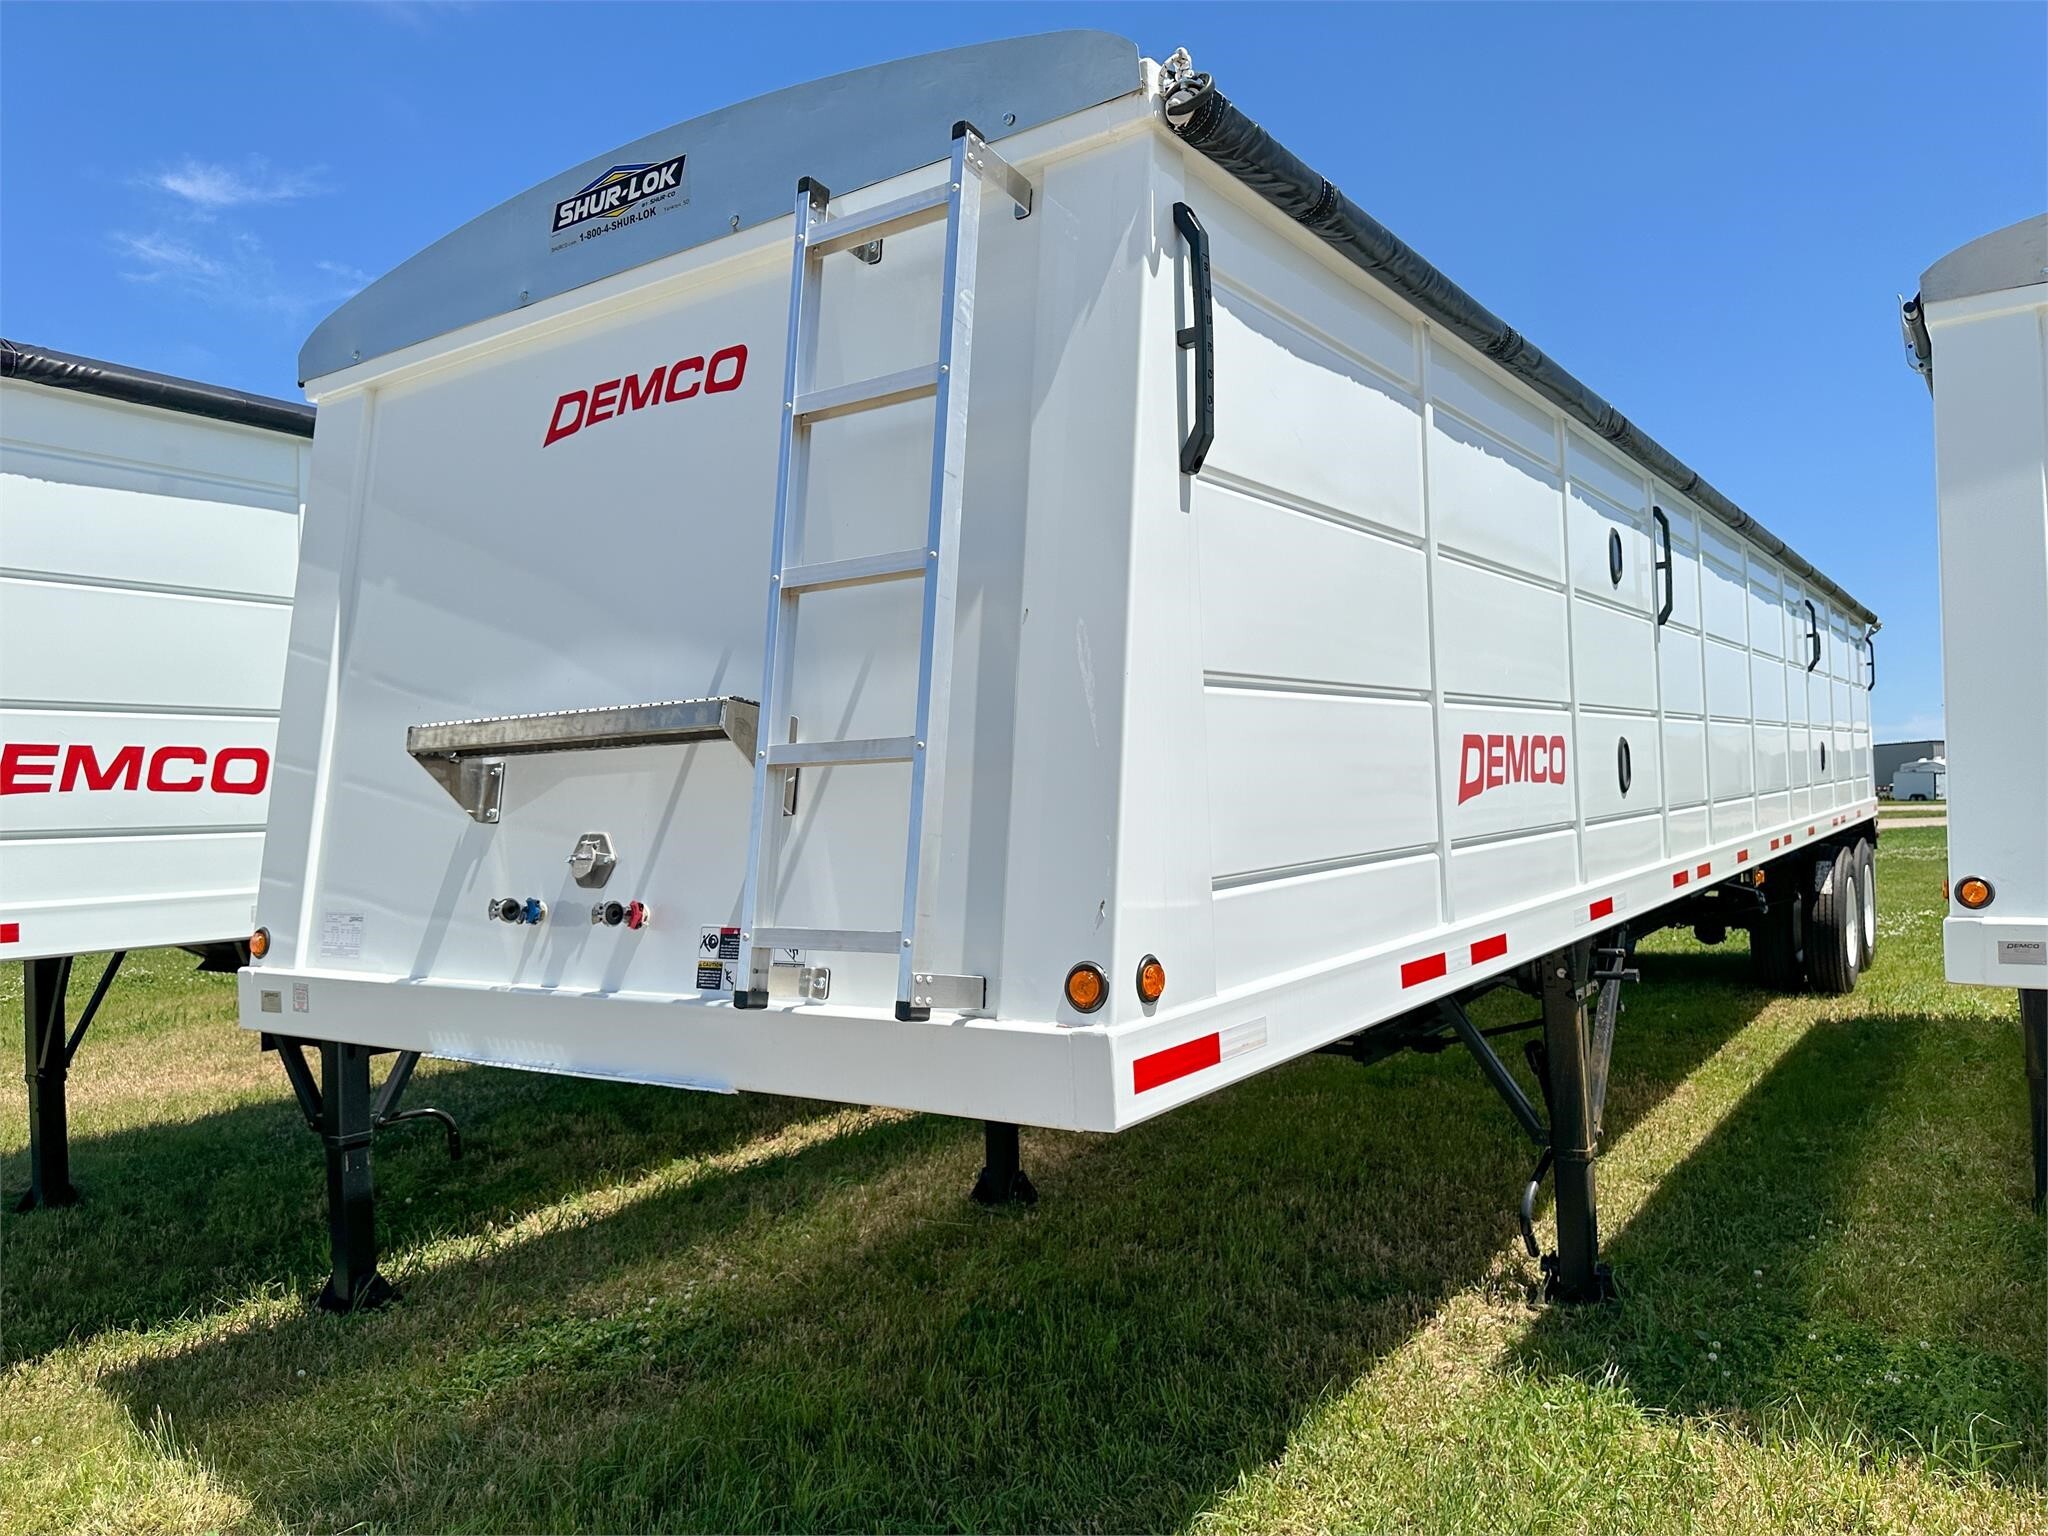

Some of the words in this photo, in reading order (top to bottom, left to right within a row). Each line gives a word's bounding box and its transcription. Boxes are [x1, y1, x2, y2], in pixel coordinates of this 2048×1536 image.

[558, 162, 679, 227] SHUR-LOK
[579, 207, 657, 242] 1-800-4-SHUR-LOK
[543, 344, 748, 448] DEMCO
[1458, 734, 1566, 806] DEMCO
